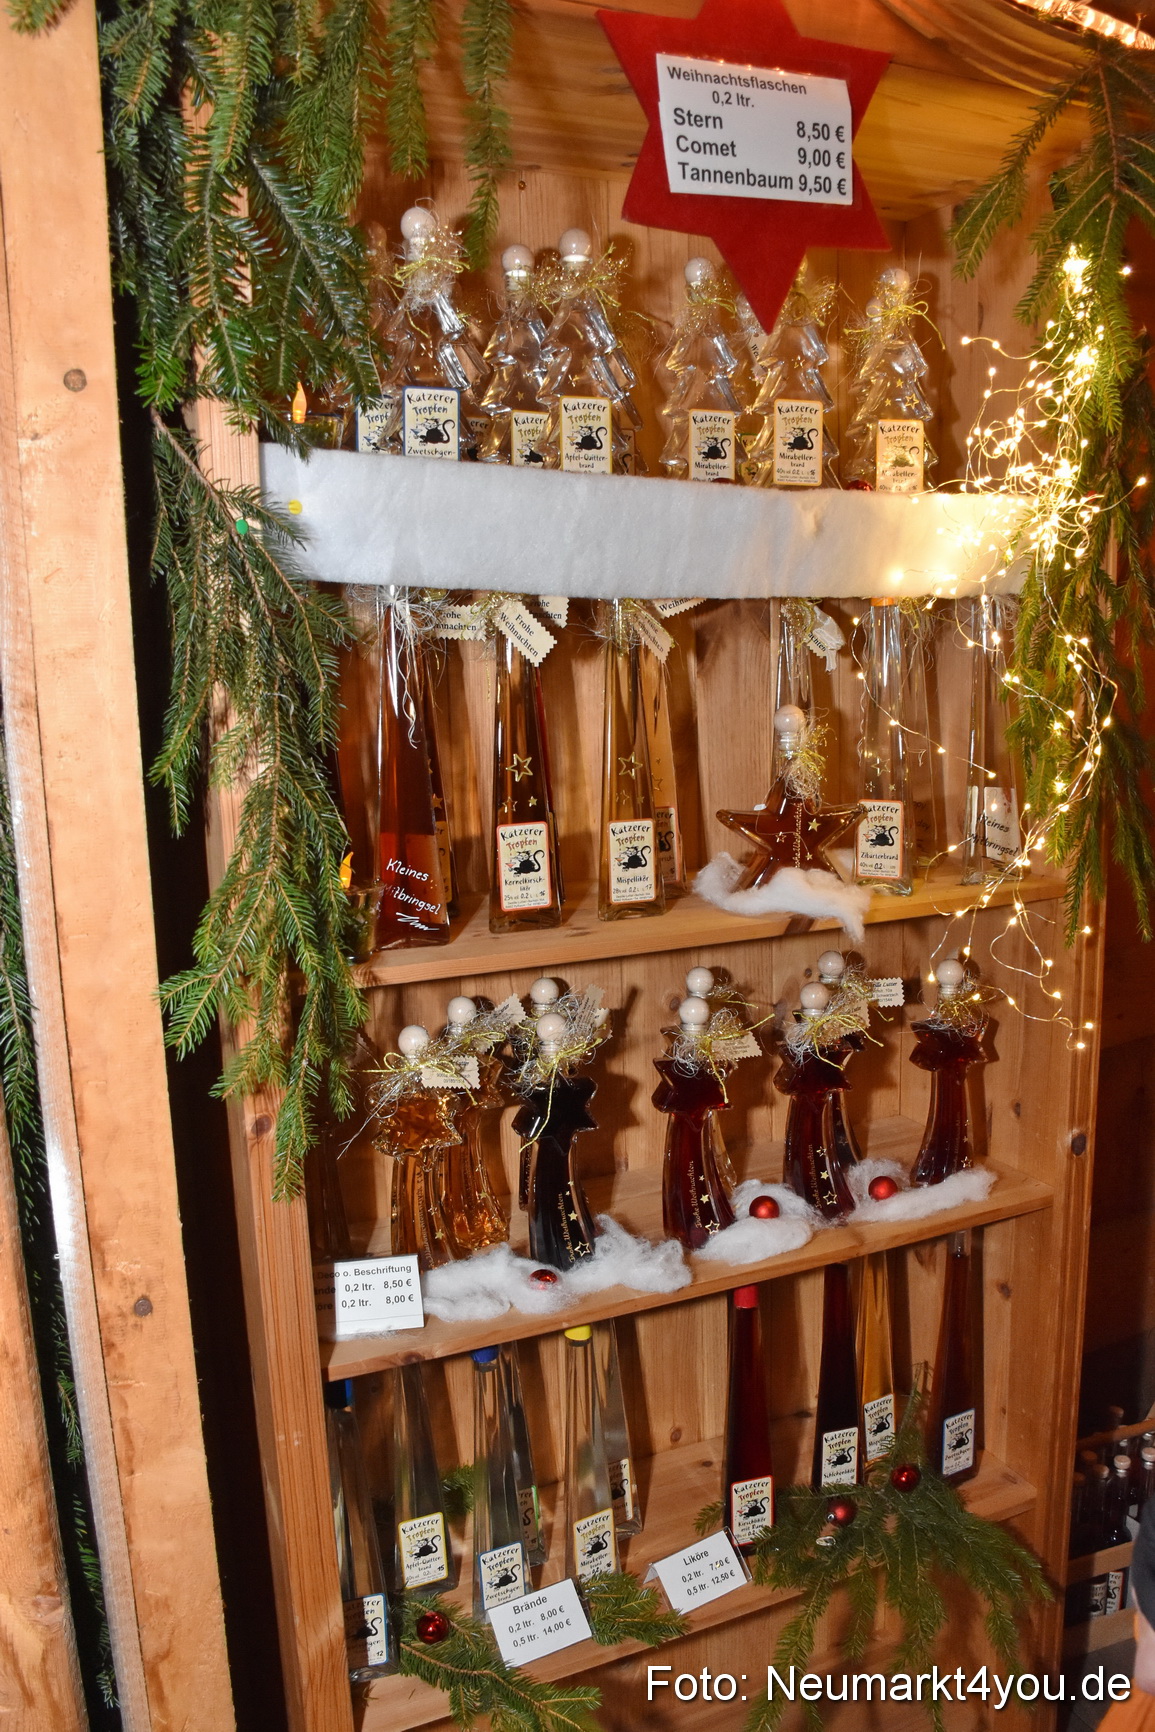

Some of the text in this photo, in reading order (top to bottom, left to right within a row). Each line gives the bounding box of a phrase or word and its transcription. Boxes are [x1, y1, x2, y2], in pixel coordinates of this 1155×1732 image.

[667, 66, 807, 95] Weihnachtsflaschen
[712, 91, 754, 108] 0,2 ltr.
[673, 108, 845, 146] Stern 8,50 €
[676, 135, 845, 172] Comet 9,00 €
[678, 162, 847, 196] Tannenbaum 9,50 €
[407, 393, 455, 404] Katzerer
[412, 403, 448, 416] Tropfen
[563, 402, 607, 413] Katzerer
[778, 404, 819, 415] Katzerer
[568, 411, 601, 424] Tropfen
[692, 415, 731, 425] Katzerer
[782, 413, 812, 426] Tropfen
[697, 423, 725, 435] Tropfen
[880, 425, 920, 435] Katzerer
[884, 433, 914, 444] Tropfen
[442, 611, 461, 619] rohe
[515, 614, 535, 637] Frohe
[500, 612, 539, 658] Weihnachten
[500, 828, 544, 841] Katzerer
[611, 824, 651, 836] Katzerer
[506, 839, 537, 851] Tropfen
[616, 834, 645, 846] Tropfen
[386, 858, 429, 882] Kleines
[354, 1265, 412, 1277] Beschriftung
[345, 1283, 359, 1293] 0,2
[362, 1282, 375, 1291] ltr.
[383, 1279, 403, 1290] 8,50
[406, 1278, 412, 1287] €
[342, 1299, 356, 1309] 0,2
[358, 1298, 372, 1307] ltr.
[386, 1294, 405, 1305] 8,00
[408, 1293, 414, 1302] €
[865, 1399, 892, 1414] Katzerer
[868, 1407, 888, 1420] Tropfen
[946, 1414, 973, 1429] Katzerer
[949, 1422, 969, 1435] Tropfen
[824, 1431, 856, 1443] Katzerer
[828, 1438, 851, 1449] Tropfen
[734, 1481, 769, 1495] Katzerer
[738, 1489, 764, 1501] Tropfen
[401, 1518, 440, 1535] Katzerer
[576, 1515, 610, 1533] Katzerer
[406, 1527, 435, 1541] Tropfen
[581, 1524, 606, 1540] Tropfen
[481, 1547, 519, 1565] Katzerer
[683, 1550, 709, 1566] Liköre
[486, 1557, 514, 1571] Tropfen
[681, 1573, 693, 1583] 0,2
[693, 1570, 704, 1580] ltr.
[725, 1557, 730, 1565] €
[687, 1569, 735, 1596] 0,5 ltr. 12,50 €
[513, 1596, 548, 1614] Brände
[508, 1605, 565, 1633] 0,2 ltr. 8,00 €
[512, 1618, 572, 1648] 0,5 ltr. 14,00 €
